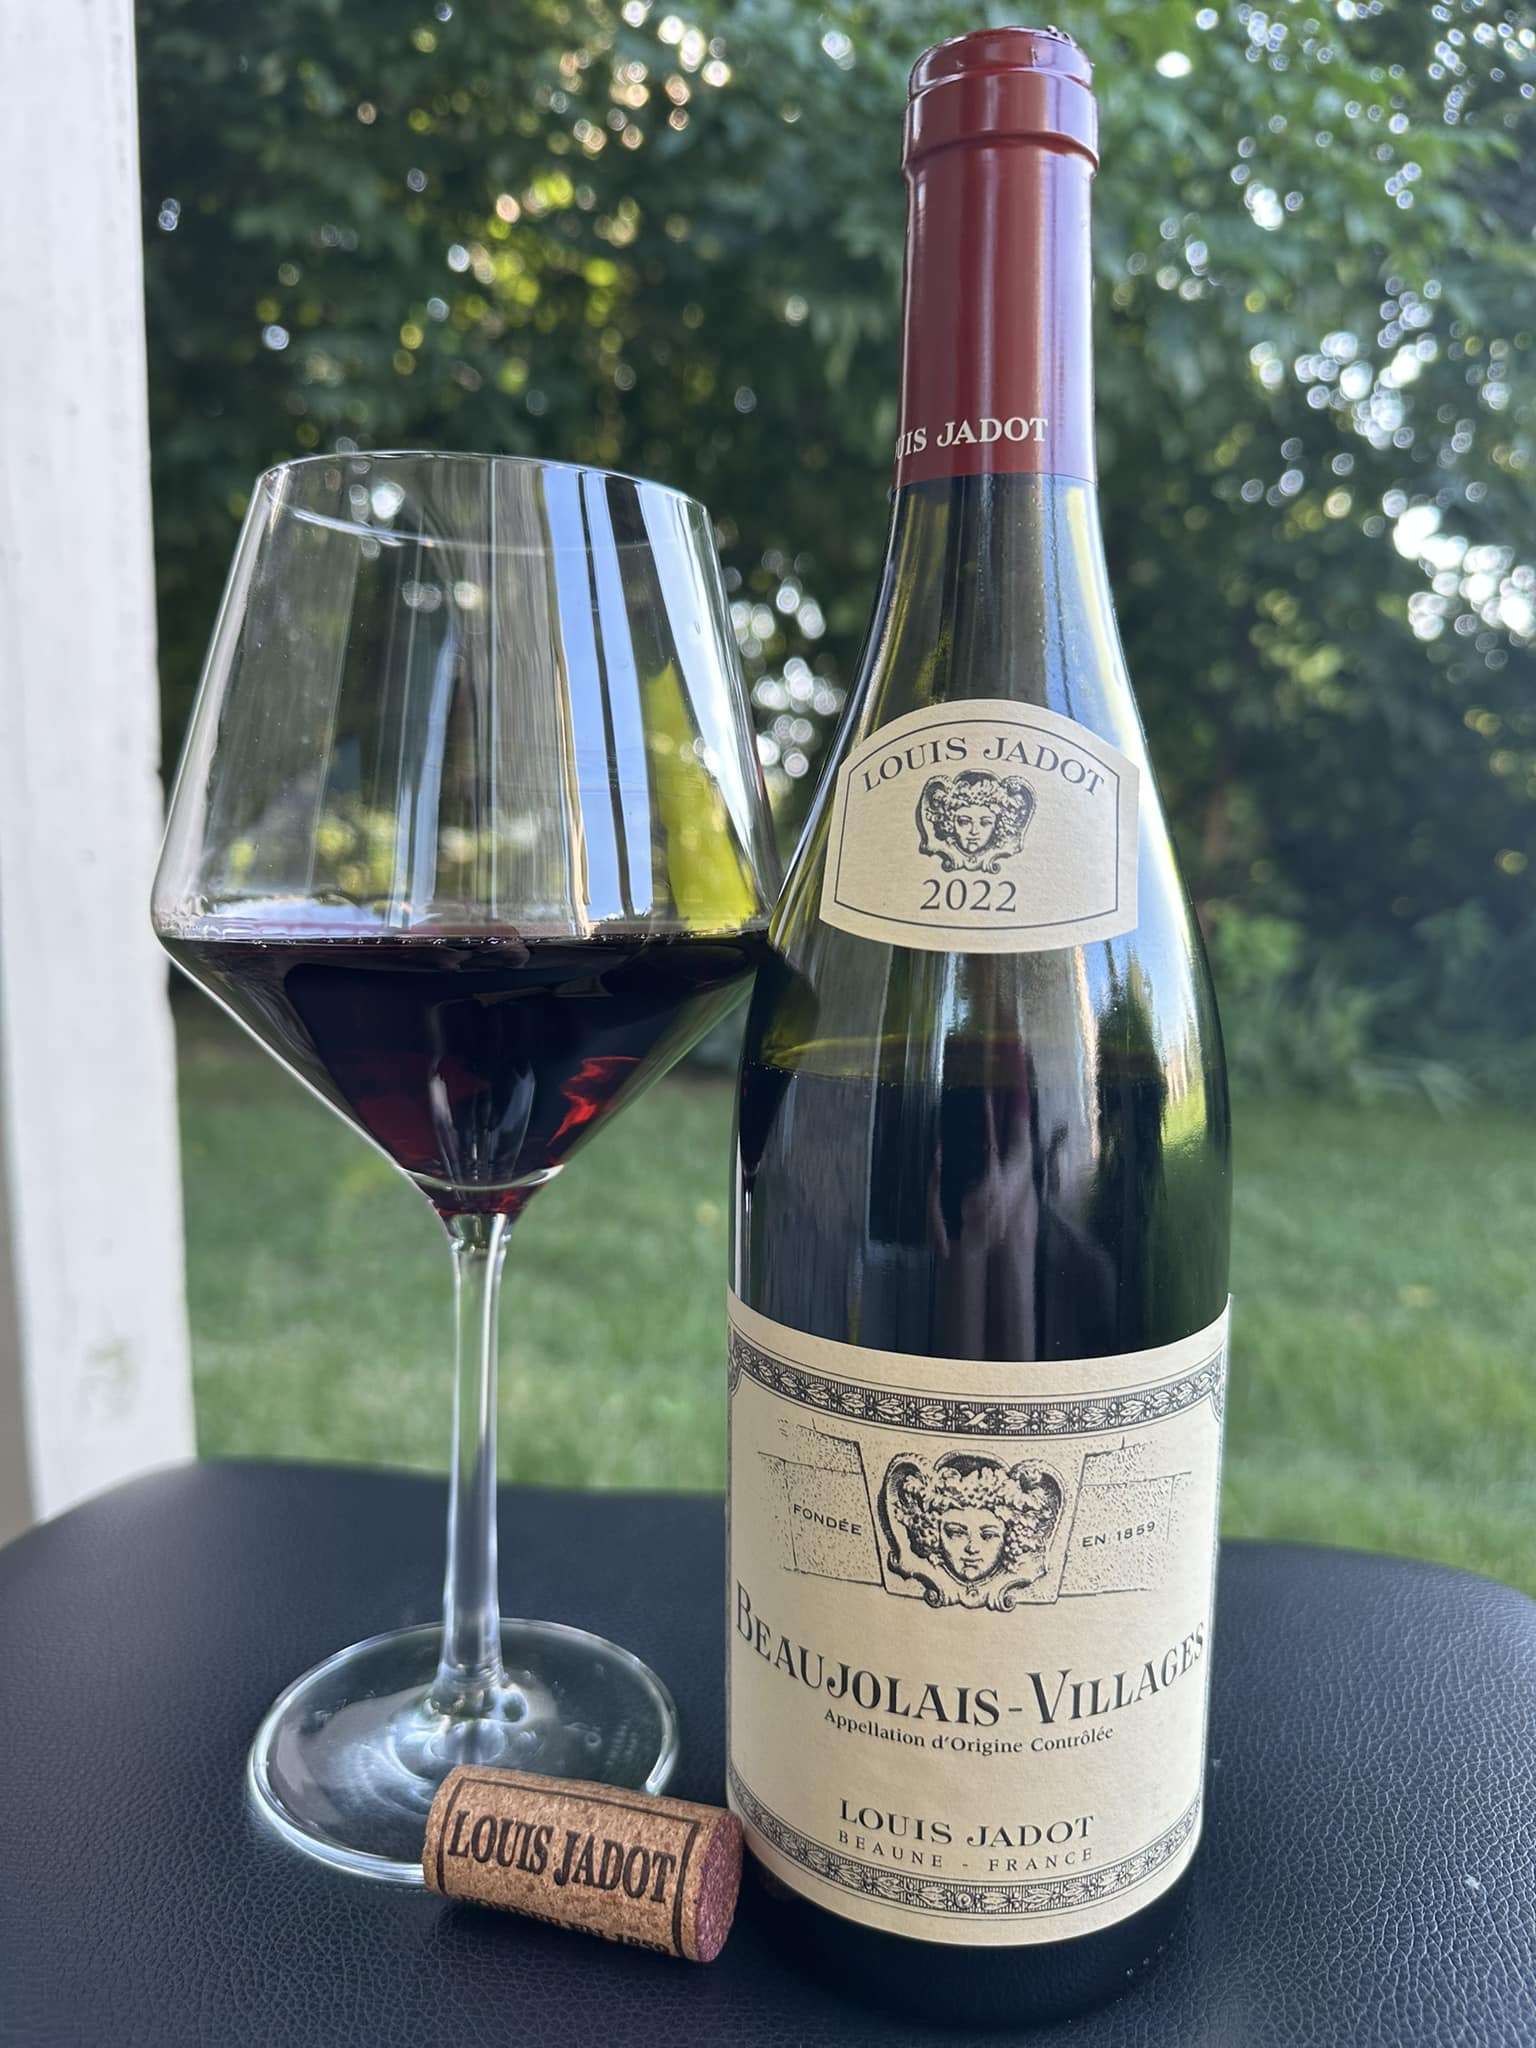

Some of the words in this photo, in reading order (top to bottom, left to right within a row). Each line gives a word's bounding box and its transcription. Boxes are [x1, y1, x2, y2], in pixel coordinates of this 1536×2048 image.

[936, 416, 1048, 447] JADOT
[861, 736, 968, 792] LOUIS
[983, 736, 1105, 795] JADOT
[919, 879, 1017, 912] 2022
[793, 1503, 862, 1536] FONDÉE
[1082, 1533, 1106, 1547] EN
[1117, 1521, 1155, 1541] 1859
[823, 1708, 926, 1748] Appellation
[931, 1735, 1023, 1756] d'Origine
[1030, 1725, 1114, 1752] Contrôlée
[839, 1798, 953, 1846] LOUIS
[967, 1815, 1094, 1848] JADOT
[447, 1810, 551, 1875] LOUIS
[553, 1830, 676, 1904] JADOT
[839, 1829, 943, 1867] BEAUNE
[988, 1847, 1093, 1872] FRANCE
